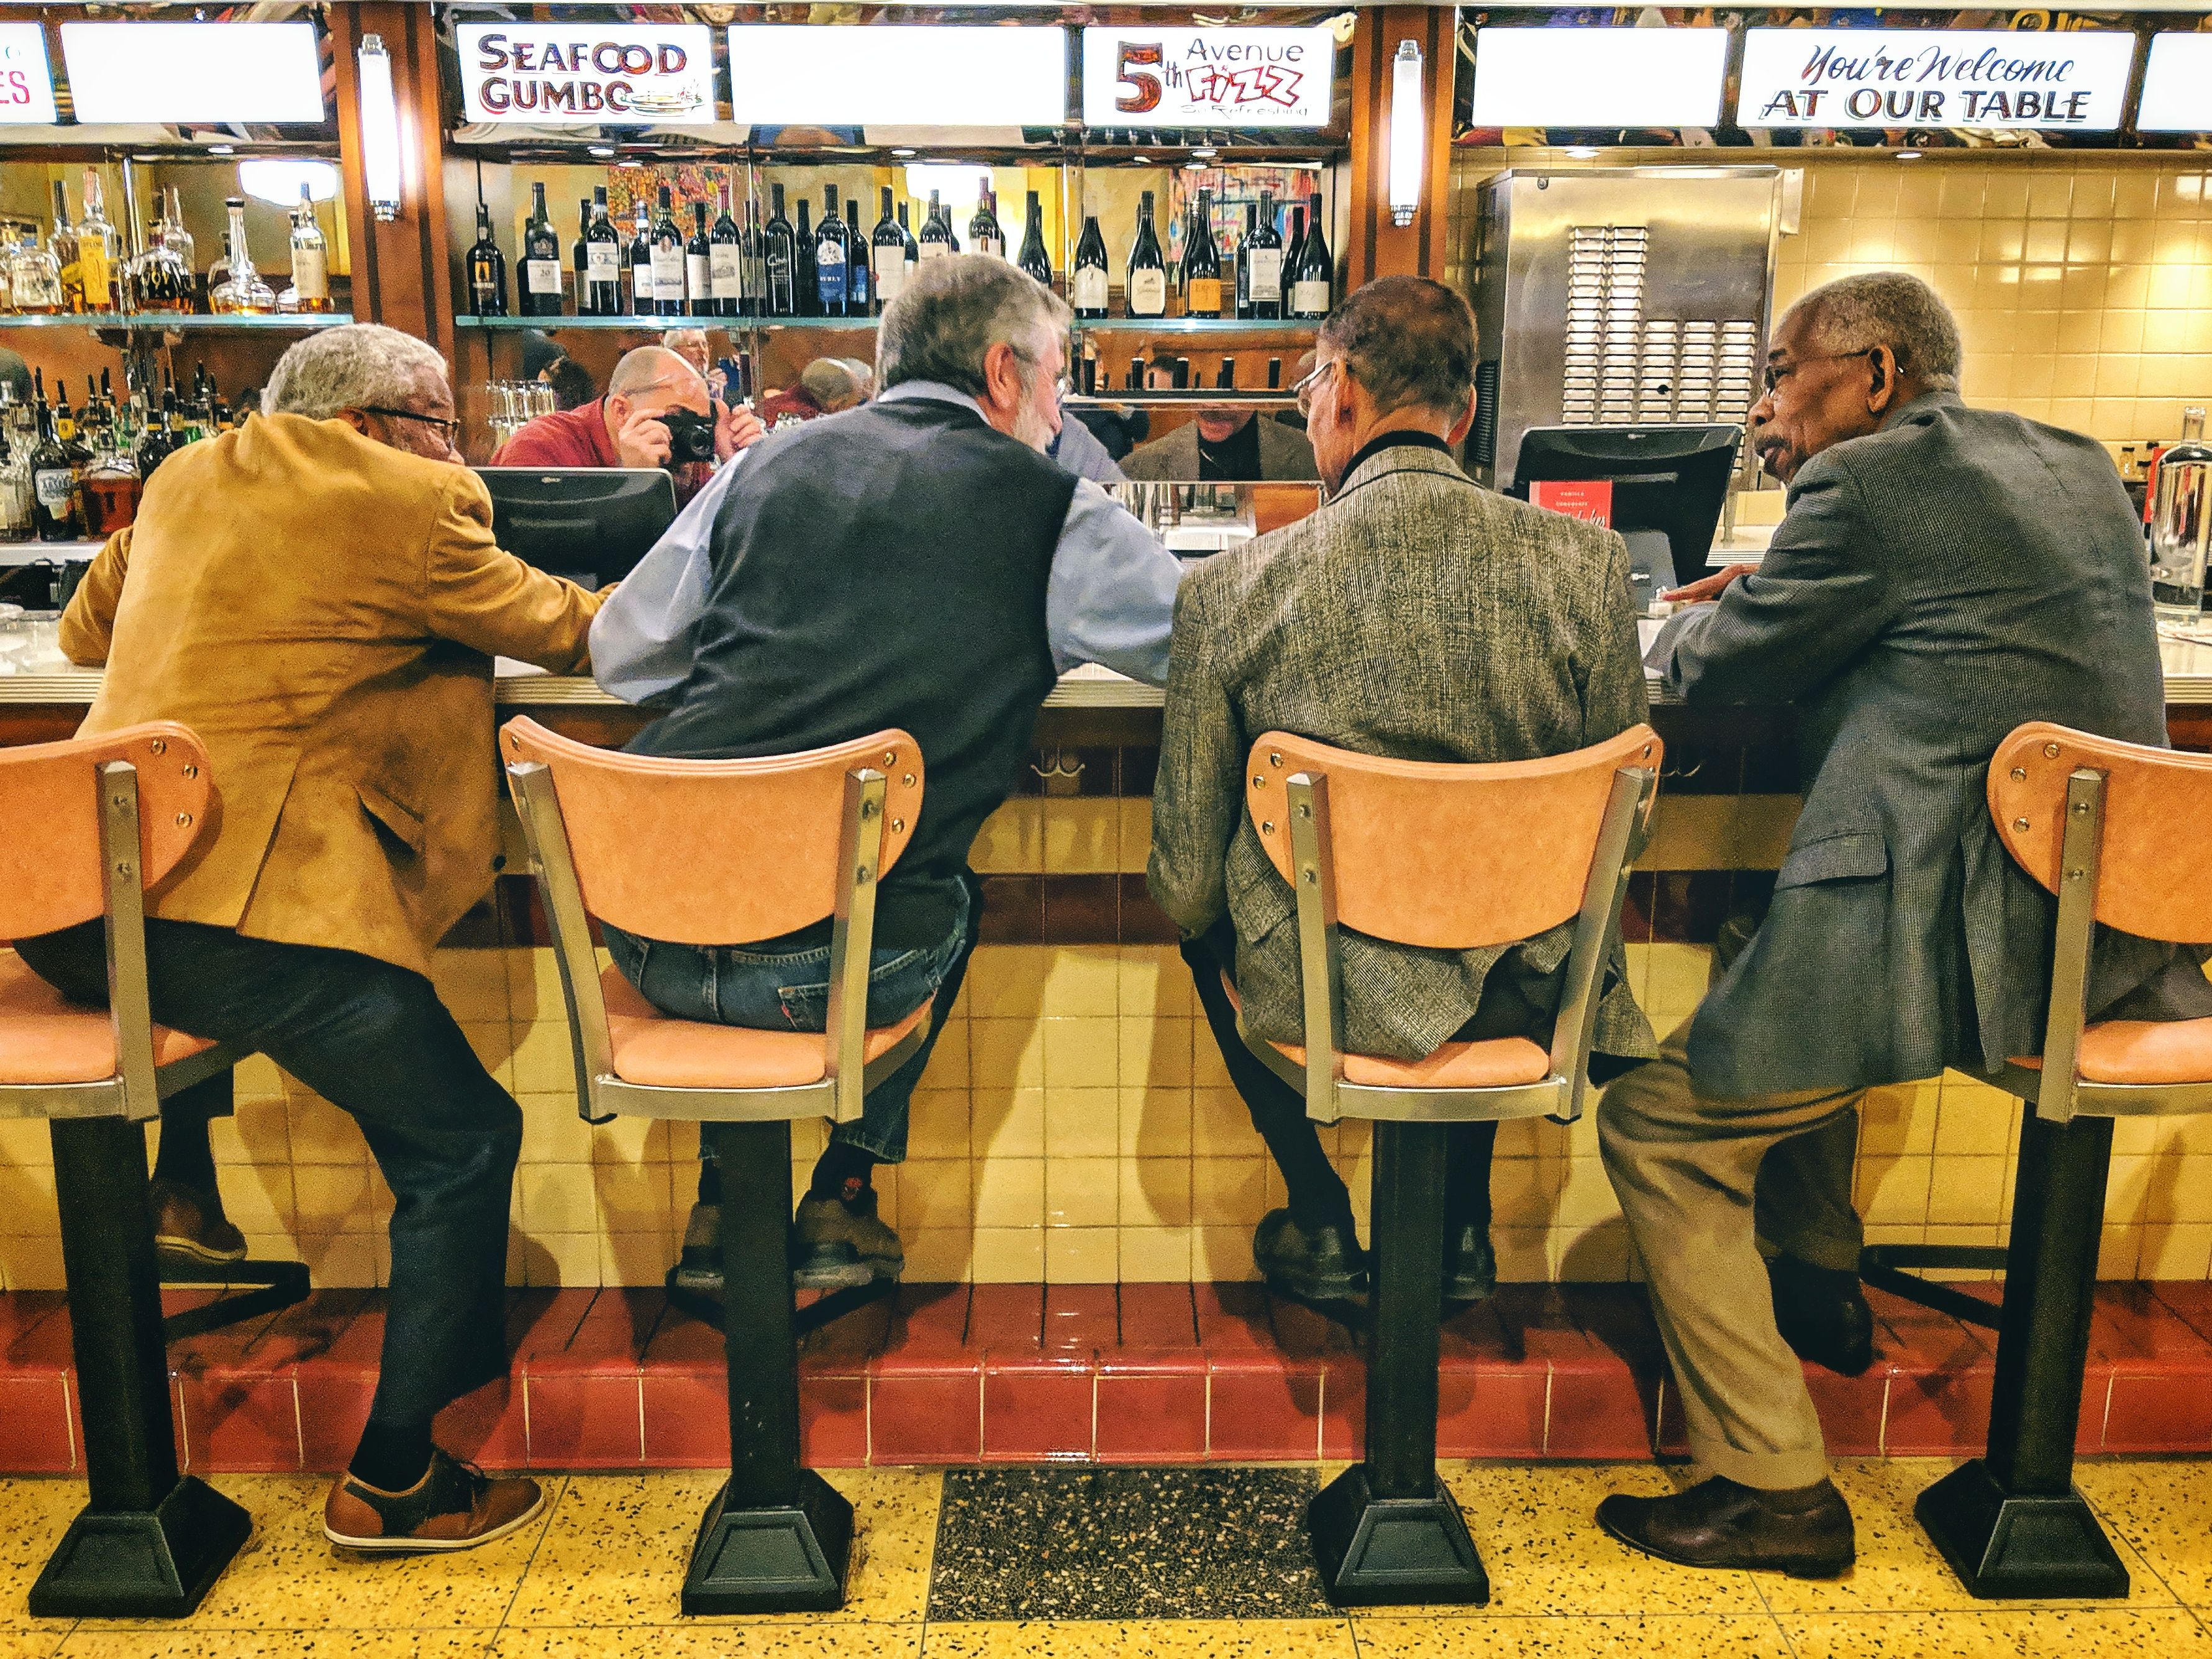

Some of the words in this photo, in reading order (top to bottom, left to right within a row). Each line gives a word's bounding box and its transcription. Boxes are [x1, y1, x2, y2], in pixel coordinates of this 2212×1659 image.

[478, 34, 687, 76] SEAFOOD
[1187, 39, 1304, 62] Avenue
[1801, 45, 1913, 86] You're
[1916, 46, 2075, 83] Welcome
[1761, 90, 1829, 121] AT
[1846, 88, 1946, 120] OUR
[1960, 91, 2092, 121] TABLE
